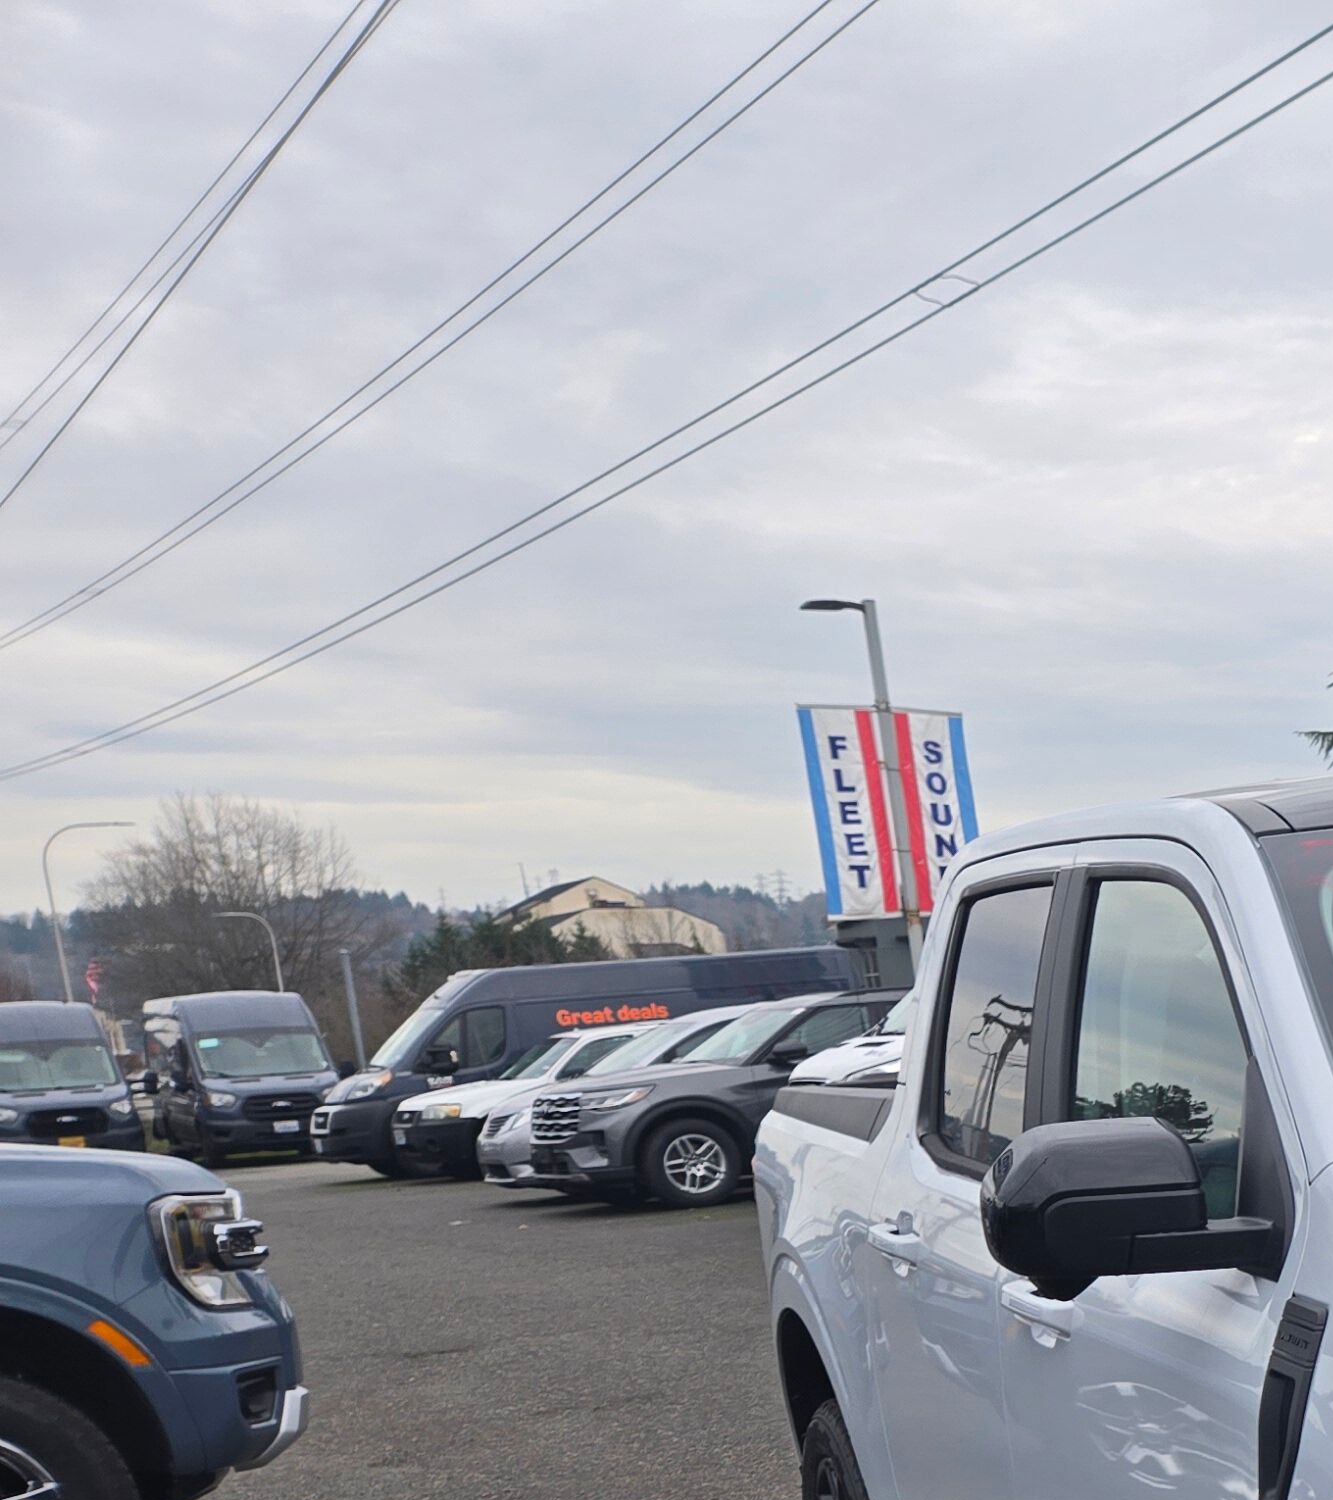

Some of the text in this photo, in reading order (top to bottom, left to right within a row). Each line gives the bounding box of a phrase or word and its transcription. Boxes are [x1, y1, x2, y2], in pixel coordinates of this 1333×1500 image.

[828, 735, 871, 889] FLEET
[922, 740, 958, 881] SOUN
[556, 1001, 669, 1026] Great deals
